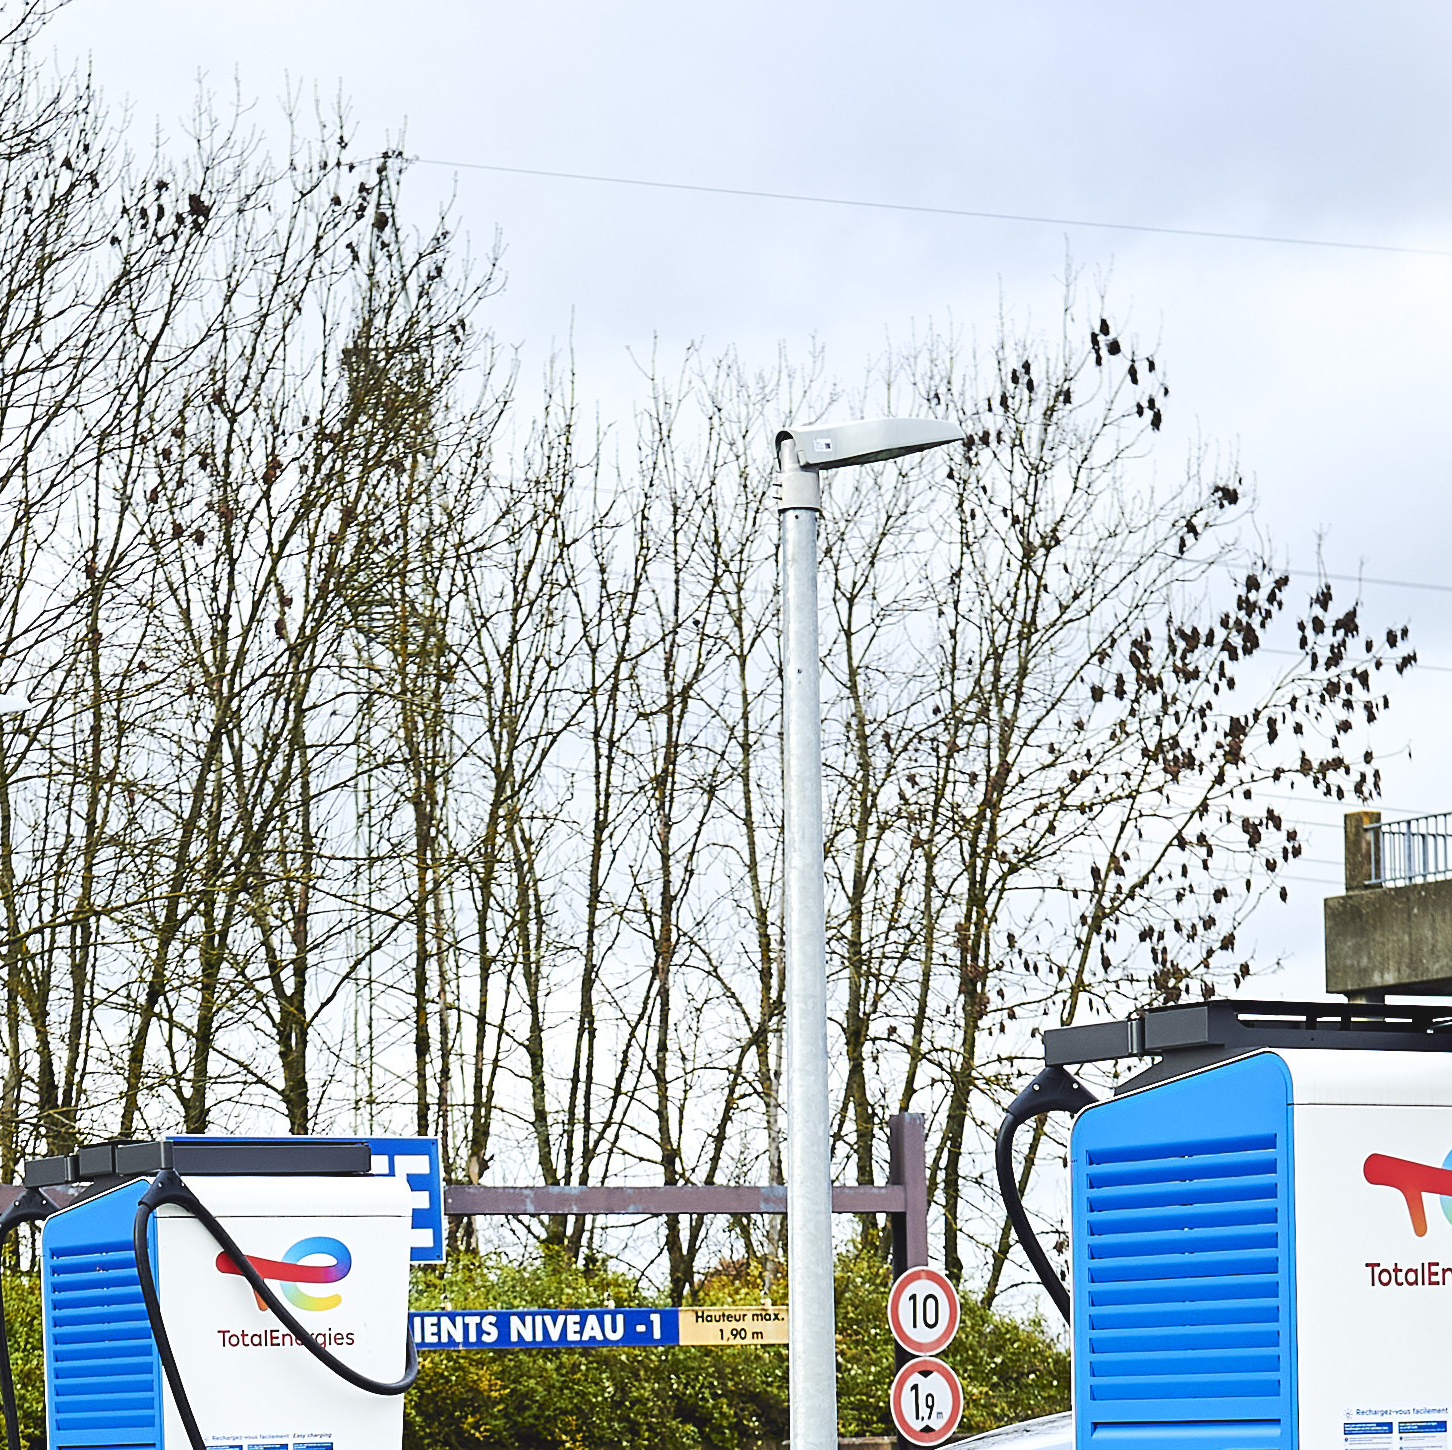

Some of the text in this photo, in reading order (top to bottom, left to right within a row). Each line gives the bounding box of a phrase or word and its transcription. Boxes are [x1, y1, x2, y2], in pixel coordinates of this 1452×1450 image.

[695, 1310, 785, 1323] Hauteur max.
[908, 1293, 939, 1329] 10
[509, 1314, 624, 1342] NIVEAU
[635, 1313, 661, 1340] -1
[719, 1328, 764, 1342] 1,90 m
[910, 1383, 935, 1421] 1,9
